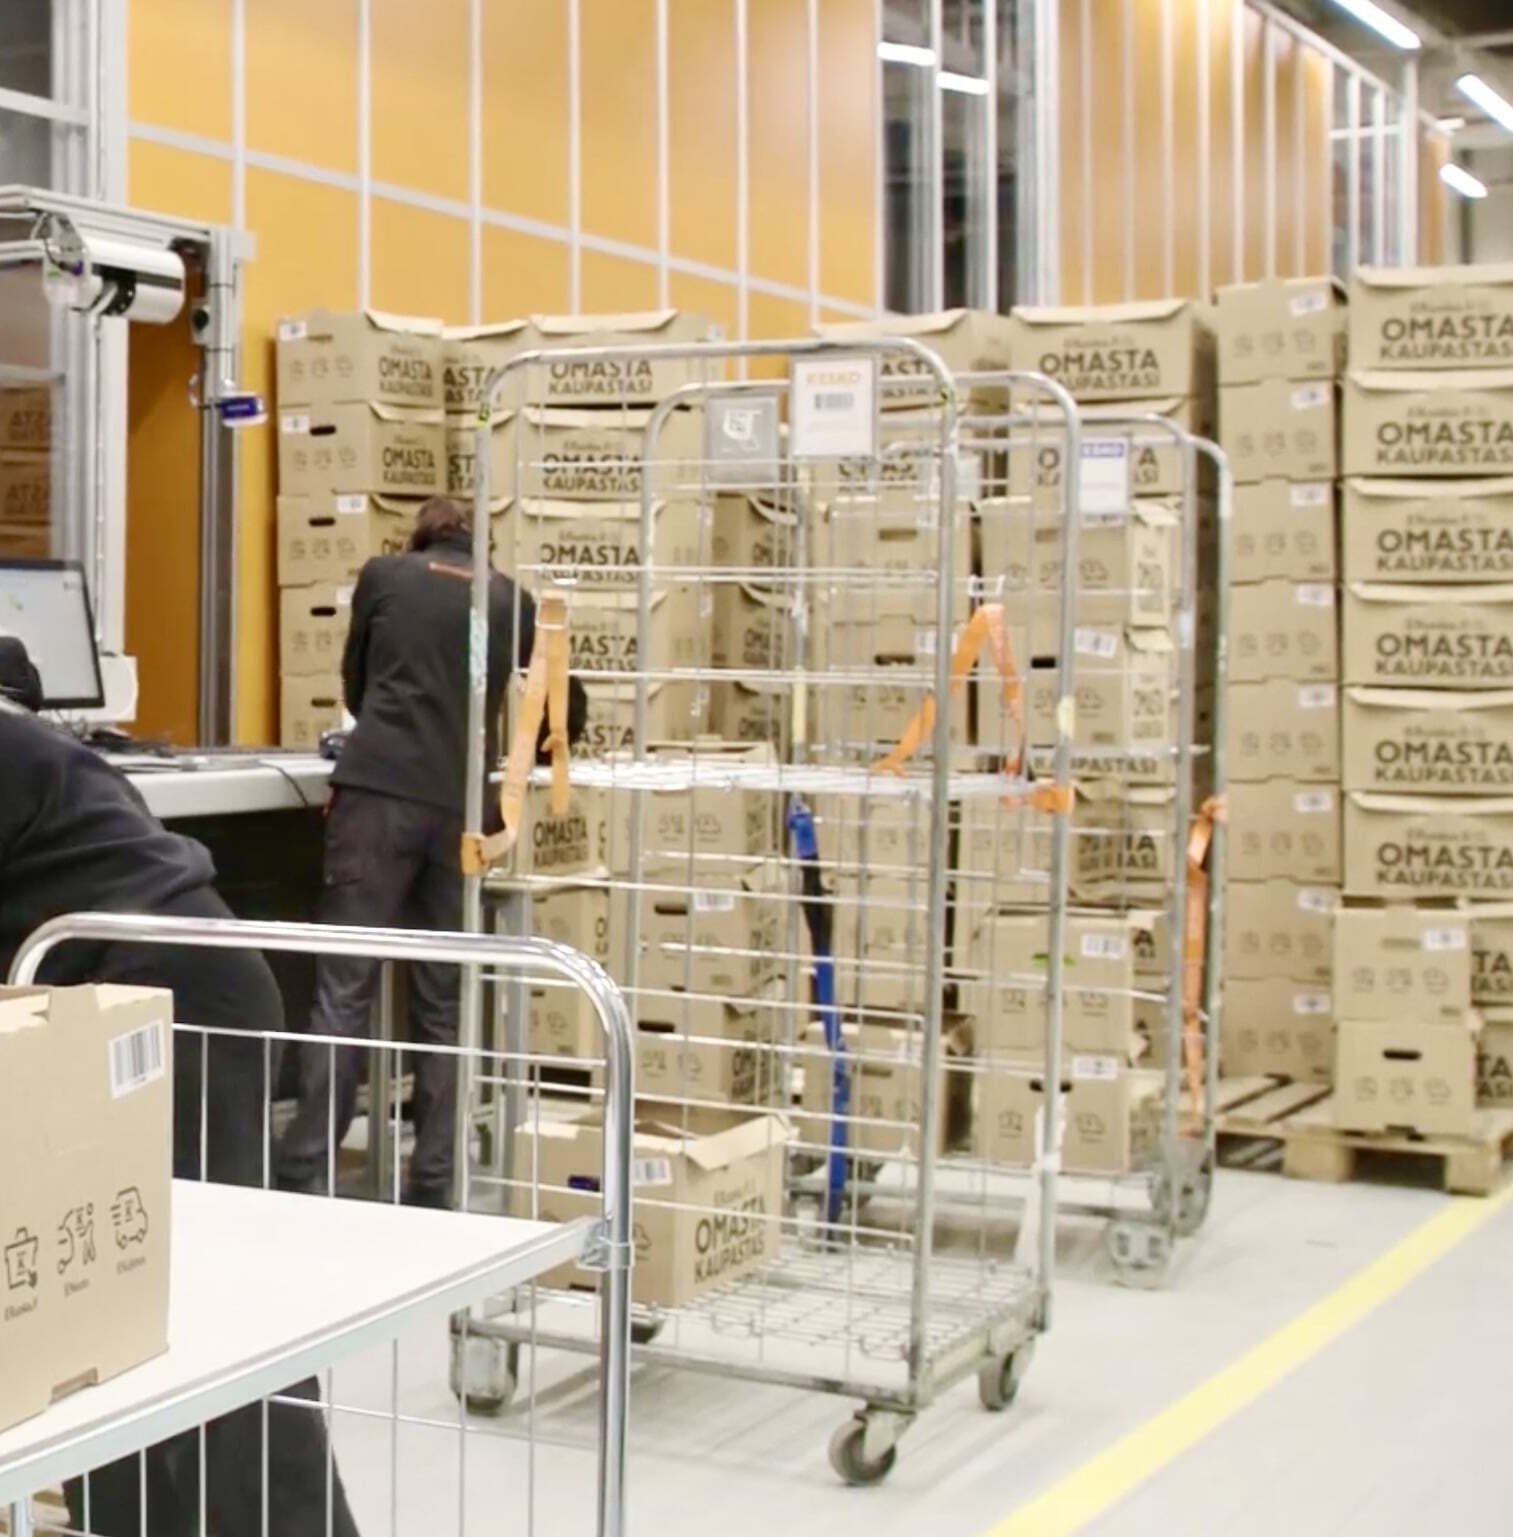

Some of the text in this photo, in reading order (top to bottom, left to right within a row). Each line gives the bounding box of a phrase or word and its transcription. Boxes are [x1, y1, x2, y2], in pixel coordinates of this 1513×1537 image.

[1382, 315, 1513, 341] OMASTA
[1040, 350, 1159, 375] OMASTA
[1380, 341, 1513, 359] KAUPASTAS
[1377, 421, 1513, 446] OMASTA
[1376, 446, 1513, 464] KAUPASTAS
[1376, 528, 1513, 553] OMASTA
[1376, 633, 1513, 658] OMASTA
[1375, 740, 1513, 764] OMASTA
[534, 818, 587, 847] OMASTA
[1377, 842, 1513, 867] OMASTA
[695, 1193, 767, 1254] OMASTA
